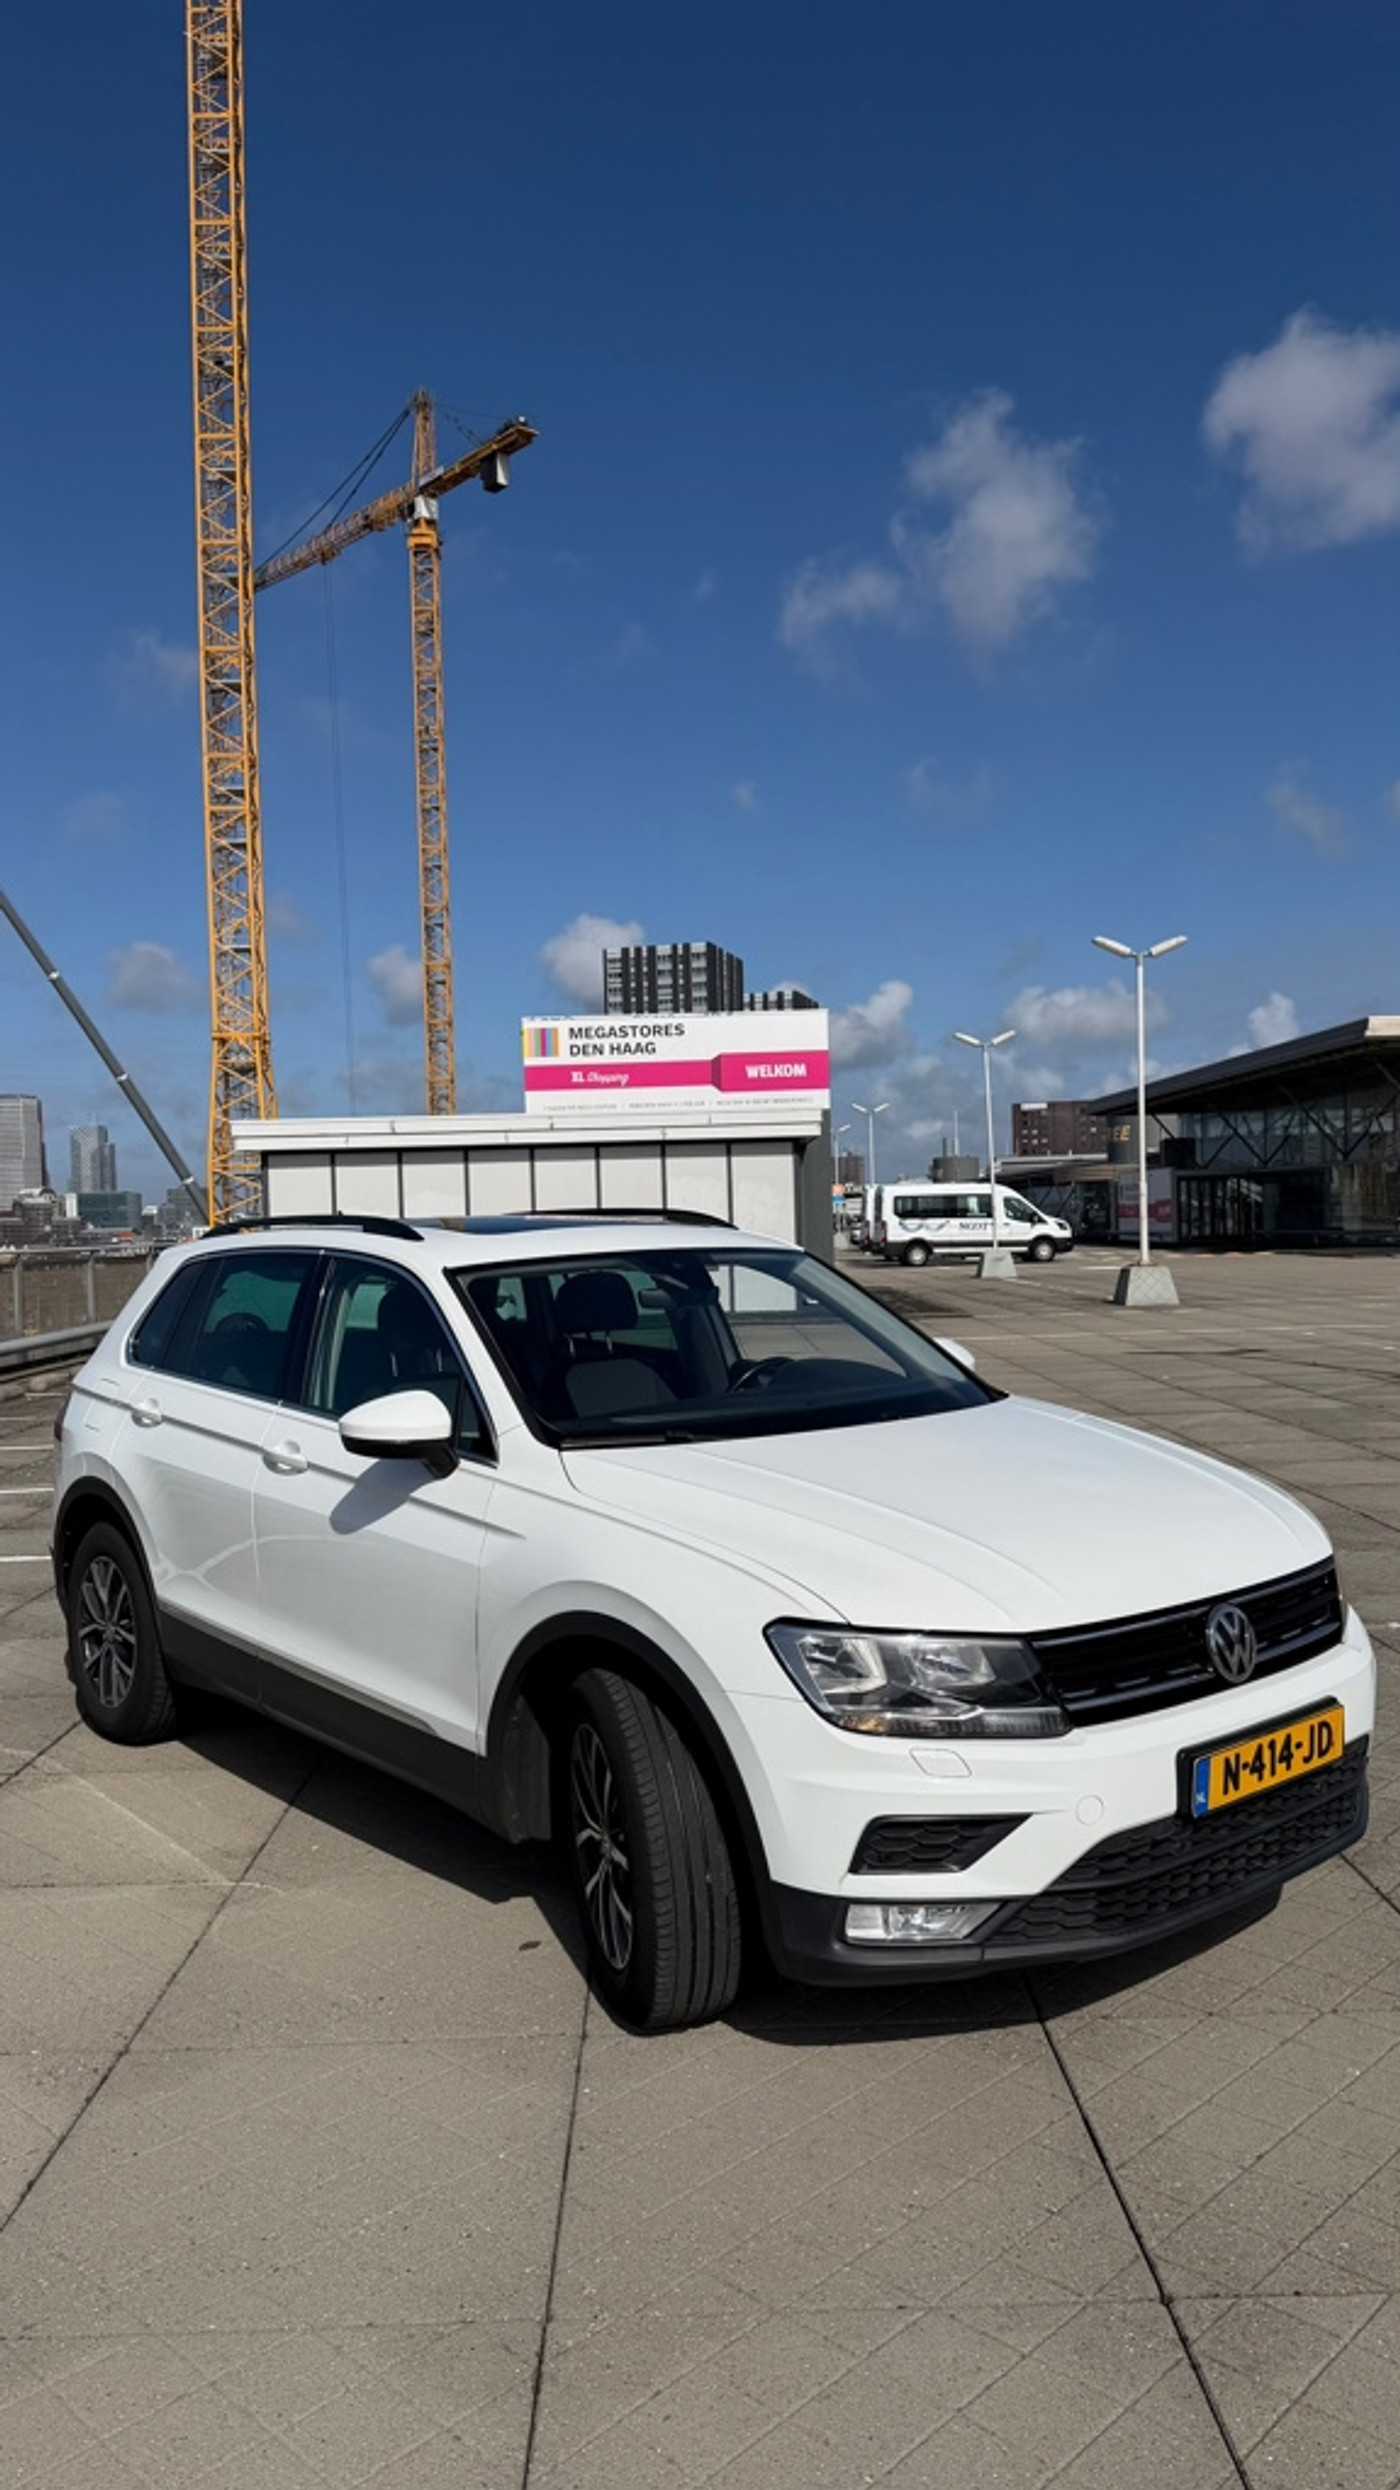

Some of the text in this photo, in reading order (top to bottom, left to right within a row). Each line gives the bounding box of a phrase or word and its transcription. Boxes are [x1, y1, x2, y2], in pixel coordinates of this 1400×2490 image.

[569, 1023, 685, 1039] MEGASTORES
[569, 1041, 657, 1057] DEN HAAG
[745, 1063, 807, 1078] WELKOM
[1222, 1720, 1334, 1796] N-414-JD
